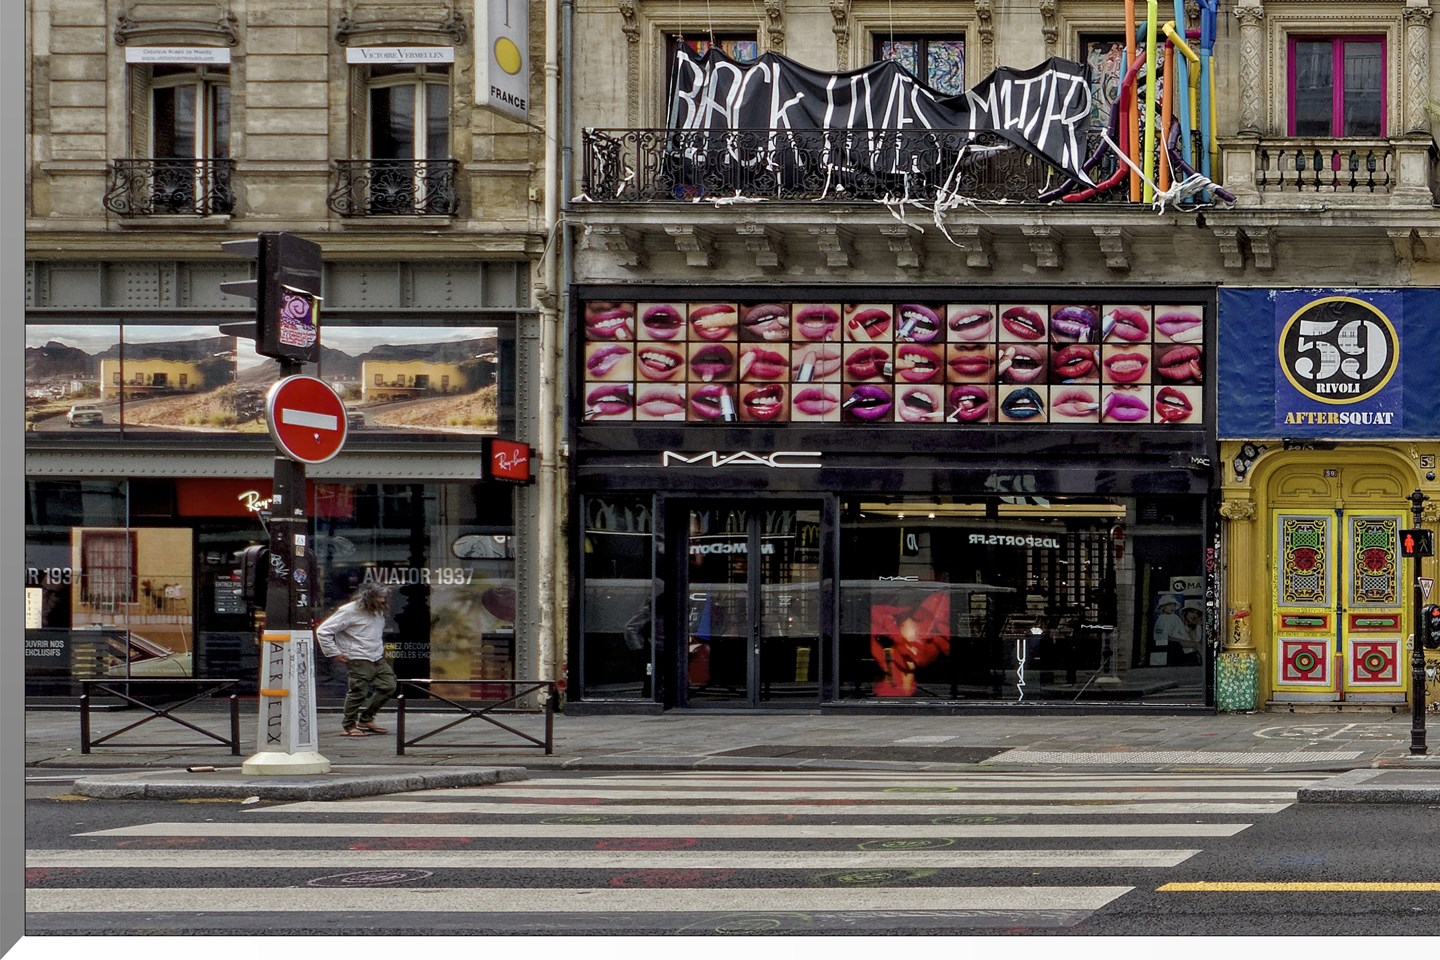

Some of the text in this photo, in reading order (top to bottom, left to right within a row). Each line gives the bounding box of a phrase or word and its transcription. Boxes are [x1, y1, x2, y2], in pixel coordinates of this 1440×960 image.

[361, 48, 444, 58] VICTOIRE VERMEULEN
[490, 85, 526, 112] FRANCE
[1294, 320, 1388, 380] 59
[1316, 383, 1360, 394] RIVOLI
[1284, 412, 1394, 425] AFTERSQUAT
[363, 567, 475, 585] AVIATOR 1937
[49, 640, 64, 648] NOS
